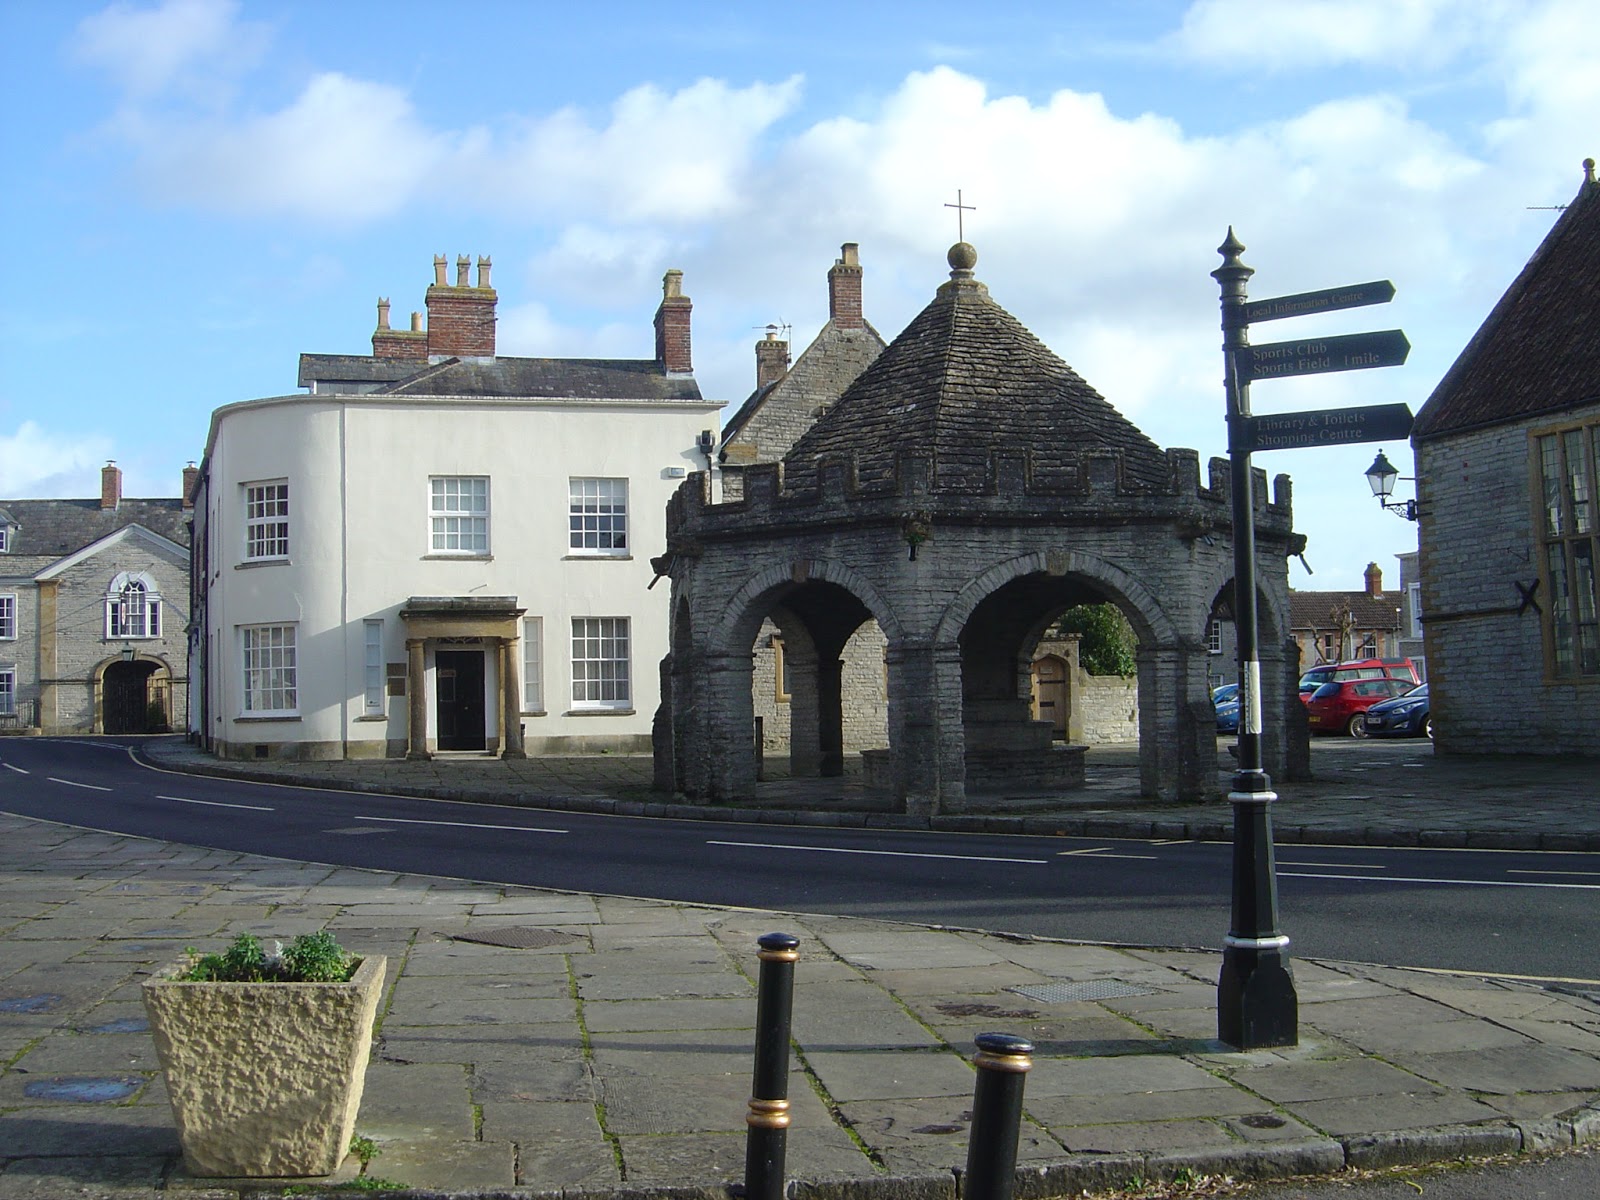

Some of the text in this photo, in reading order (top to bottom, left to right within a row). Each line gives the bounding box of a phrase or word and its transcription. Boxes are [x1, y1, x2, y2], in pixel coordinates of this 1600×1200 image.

[1246, 293, 1363, 318] Local Information Centre
[1253, 342, 1327, 362] Sports Club
[1254, 361, 1294, 376] Sports
[1298, 356, 1330, 370] Field
[1352, 352, 1380, 365] mile
[1257, 411, 1365, 431] Library & Toilets
[1257, 426, 1362, 446] Shopping Centre
